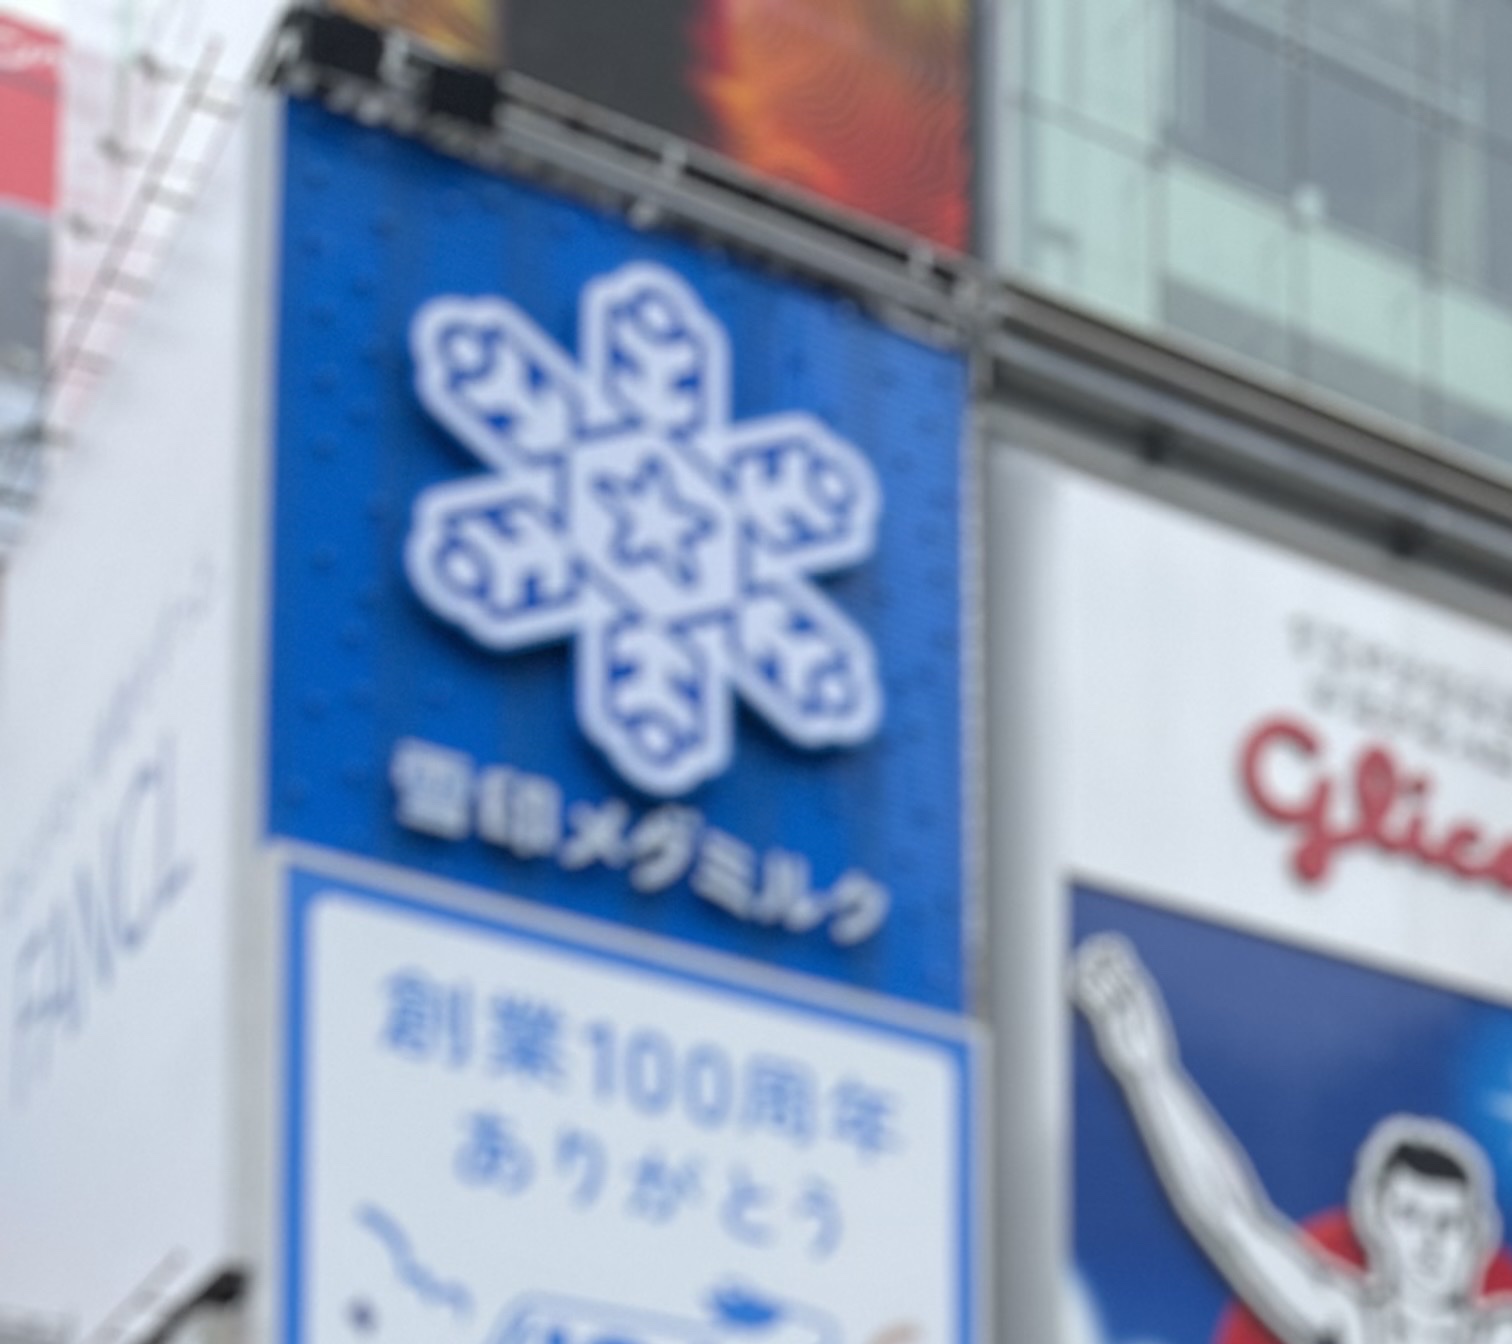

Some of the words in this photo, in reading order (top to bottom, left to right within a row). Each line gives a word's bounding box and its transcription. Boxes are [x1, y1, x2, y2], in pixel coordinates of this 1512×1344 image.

[391, 738, 892, 943] 雪印メグミルク
[383, 967, 904, 1161] 創業100周年
[452, 1110, 844, 1260] ありがとう
